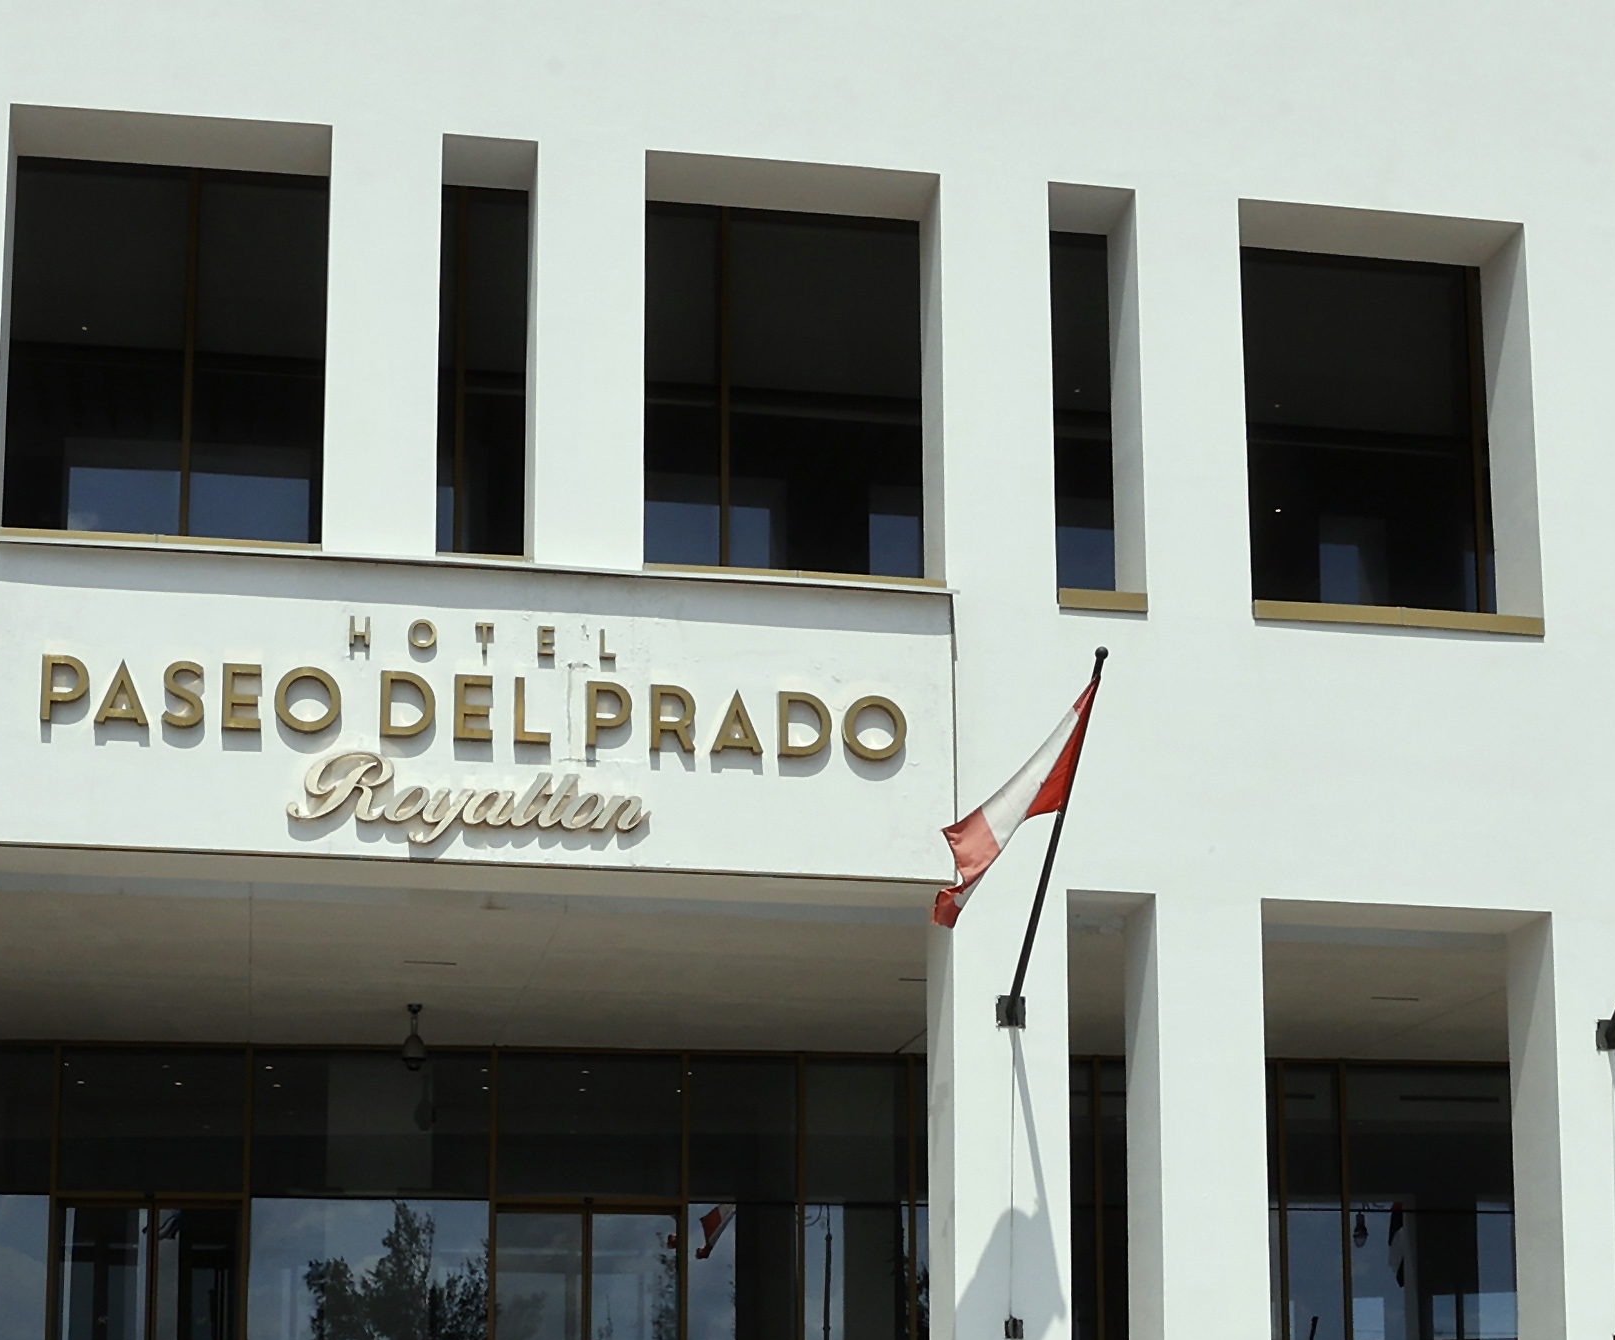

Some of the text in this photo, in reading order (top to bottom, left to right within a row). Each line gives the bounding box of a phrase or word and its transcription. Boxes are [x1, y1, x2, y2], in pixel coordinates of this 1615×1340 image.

[348, 615, 619, 661] HOTEL
[39, 654, 908, 763] PASEO DEL PRADO
[286, 751, 651, 844] Royalton
